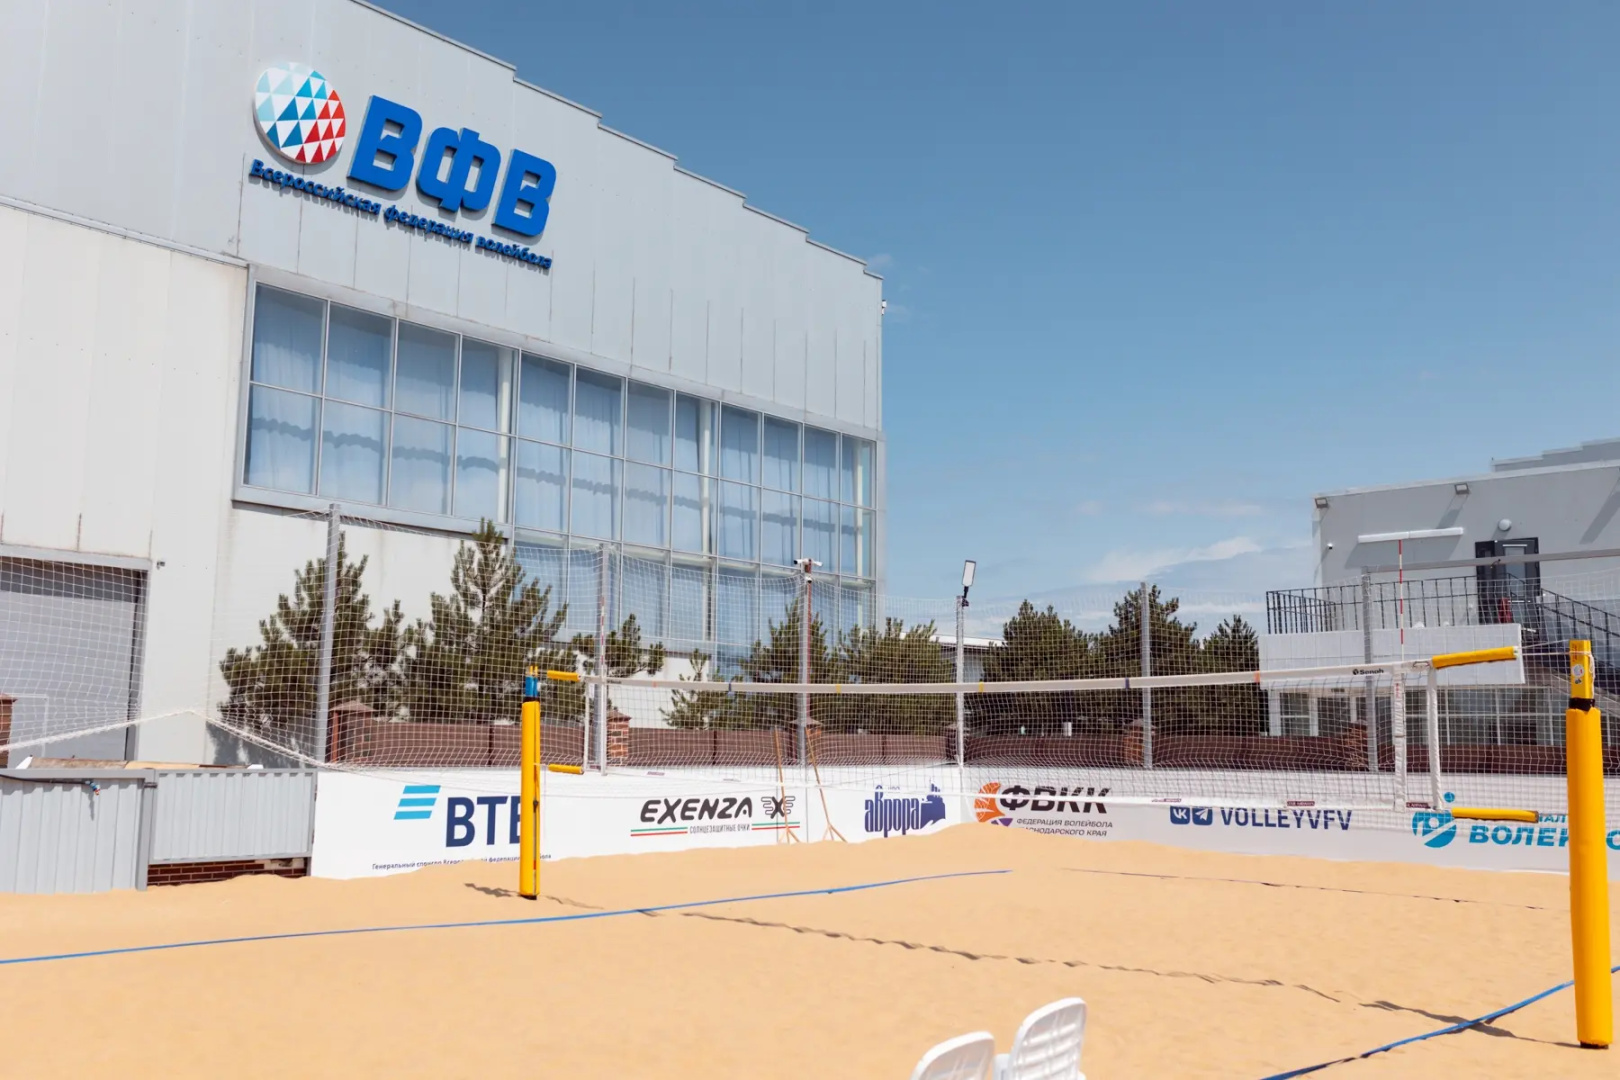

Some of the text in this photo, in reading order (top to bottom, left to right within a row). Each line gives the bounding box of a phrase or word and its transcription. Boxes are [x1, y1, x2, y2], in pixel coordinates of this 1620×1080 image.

[347, 95, 557, 237] ВФВ
[248, 159, 553, 269] Всероссийская федерация волейбола
[640, 797, 753, 824] EXENZA
[1016, 818, 1113, 828] ФЕДЕРАЦИЯ ВОЛЕЙБОЛА
[1220, 807, 1352, 830] VOLLEYVFV
